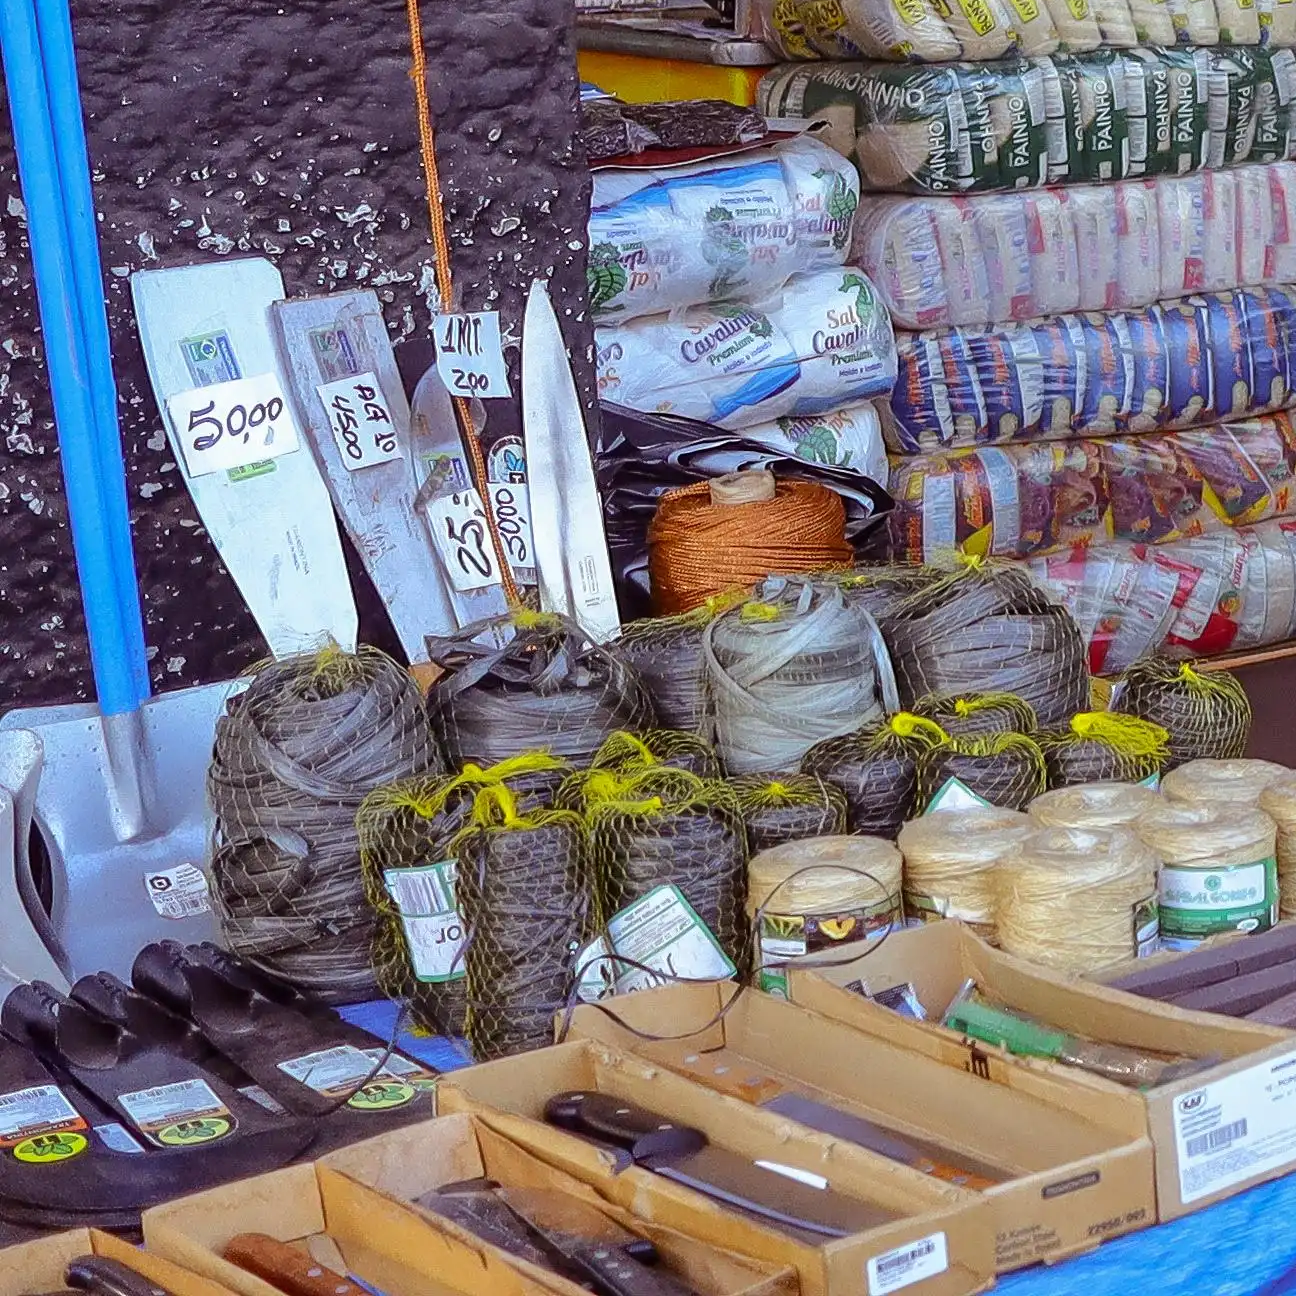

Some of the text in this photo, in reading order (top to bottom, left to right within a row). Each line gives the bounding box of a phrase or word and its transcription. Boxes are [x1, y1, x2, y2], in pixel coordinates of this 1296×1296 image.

[1014, 96, 1030, 167] PAINHO
[1094, 79, 1113, 152] PAINHO
[1153, 70, 1171, 143] PAINHO
[1177, 71, 1194, 143] PAINHO
[1234, 84, 1251, 153] PAINHO
[929, 121, 949, 190] PAINHO
[188, 397, 284, 452] 50,00
